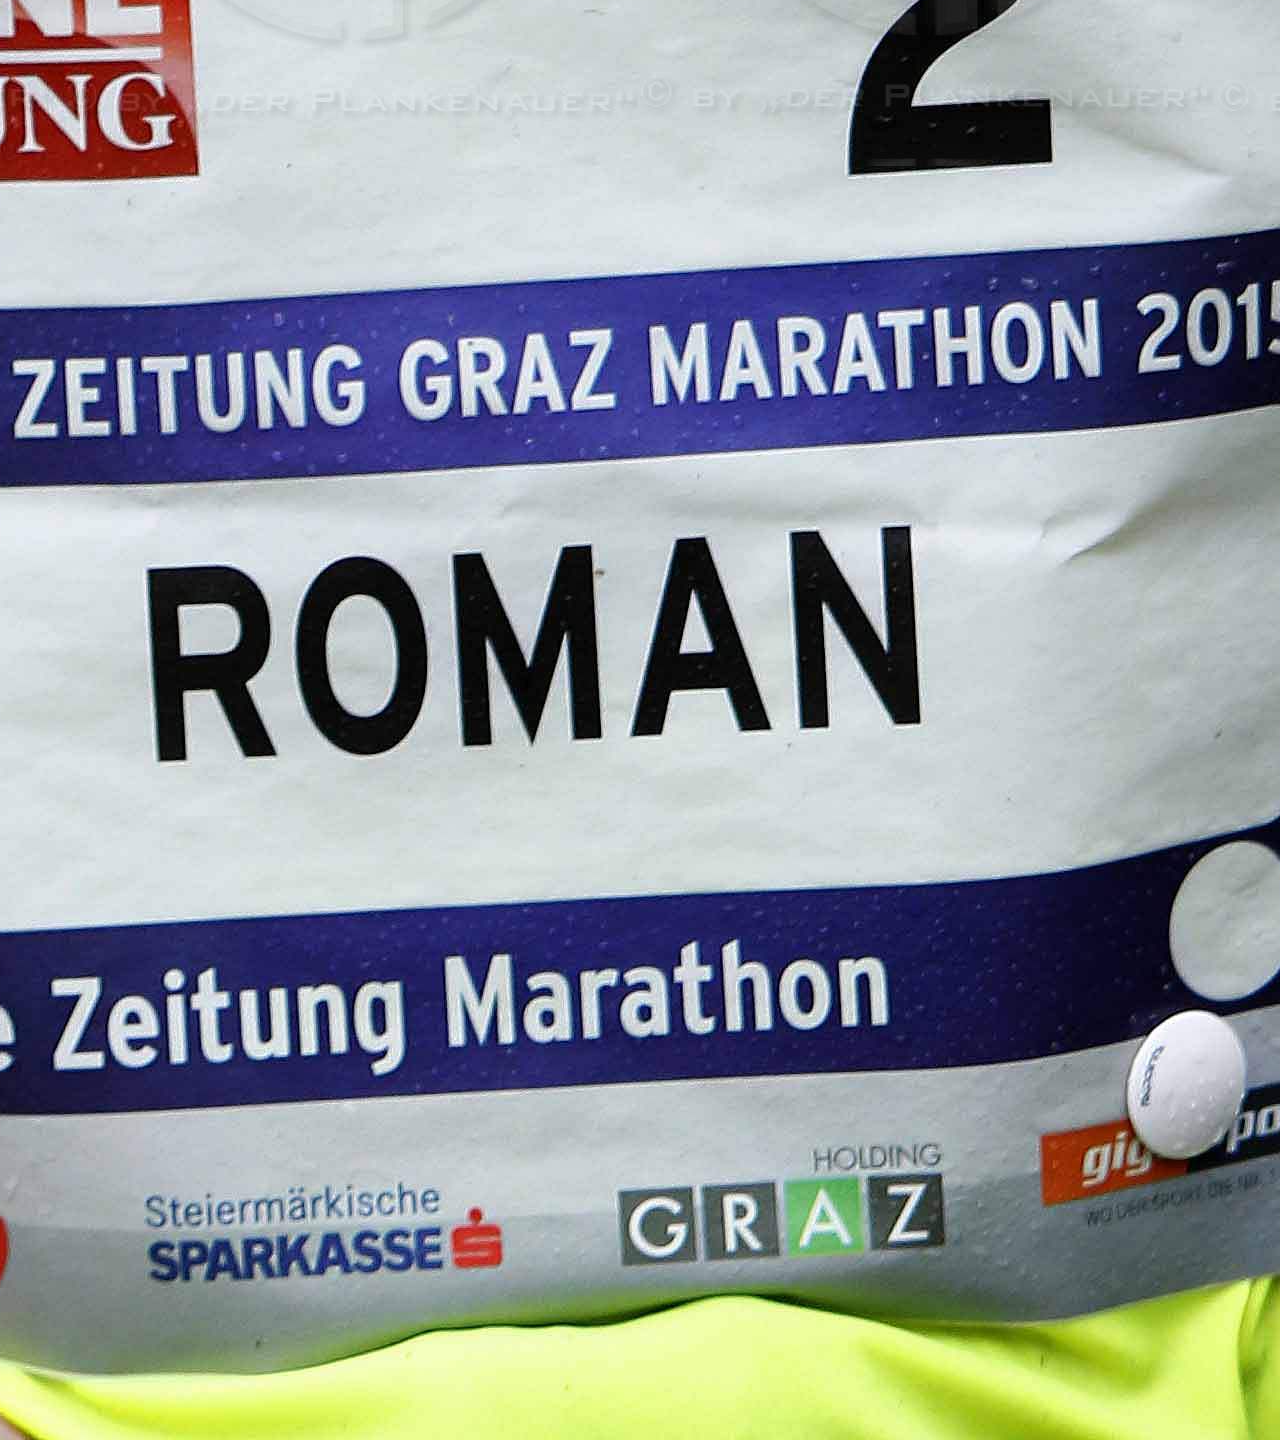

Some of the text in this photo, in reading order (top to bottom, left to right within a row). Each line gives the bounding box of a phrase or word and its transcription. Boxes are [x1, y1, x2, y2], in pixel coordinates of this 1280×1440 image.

[11, 348, 366, 440] ZEITUNG
[398, 327, 617, 422] GRAZ
[648, 297, 1102, 406] MARATHON
[147, 524, 921, 763] ROMAN
[50, 967, 406, 1076] Zeitung
[443, 938, 891, 1049] Marathon
[812, 1142, 942, 1172] HOLDING
[144, 1182, 441, 1230] Steiermärkische
[627, 1180, 931, 1261] GRAZ
[148, 1223, 444, 1283] SPARKASSE
